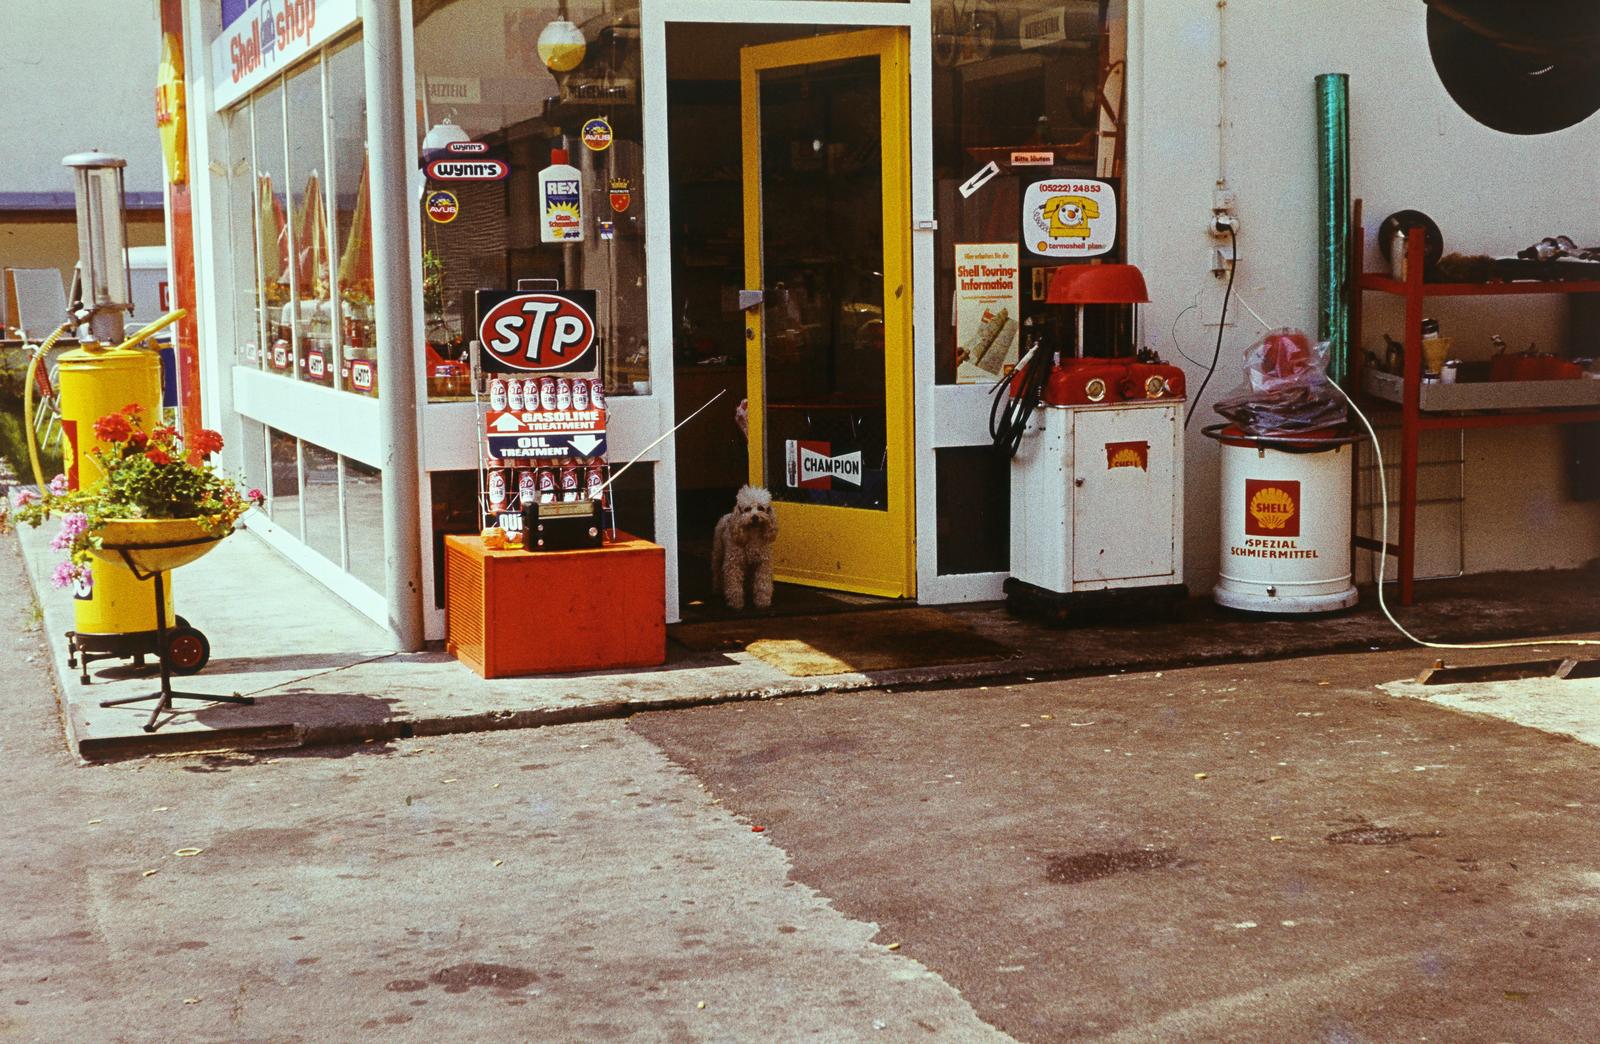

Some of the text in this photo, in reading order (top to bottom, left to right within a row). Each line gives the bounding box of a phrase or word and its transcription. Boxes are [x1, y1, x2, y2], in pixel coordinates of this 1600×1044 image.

[230, 0, 316, 84] Shell shop
[547, 182, 578, 195] REX
[1039, 183, 1101, 193] (05222) 24853
[957, 264, 1017, 279] Shell Touring-
[961, 278, 1013, 290] Information
[490, 301, 584, 360] STP
[521, 411, 599, 423] GASOLINE
[528, 421, 596, 431] TREATMENT
[517, 437, 550, 448] OIL
[500, 447, 569, 457] TREATMENT
[804, 457, 859, 475] CHAMPION
[1256, 502, 1290, 514] SHELL
[1247, 538, 1297, 549] SPEZIAL
[1231, 546, 1319, 559] SCHMIERMITTEL
